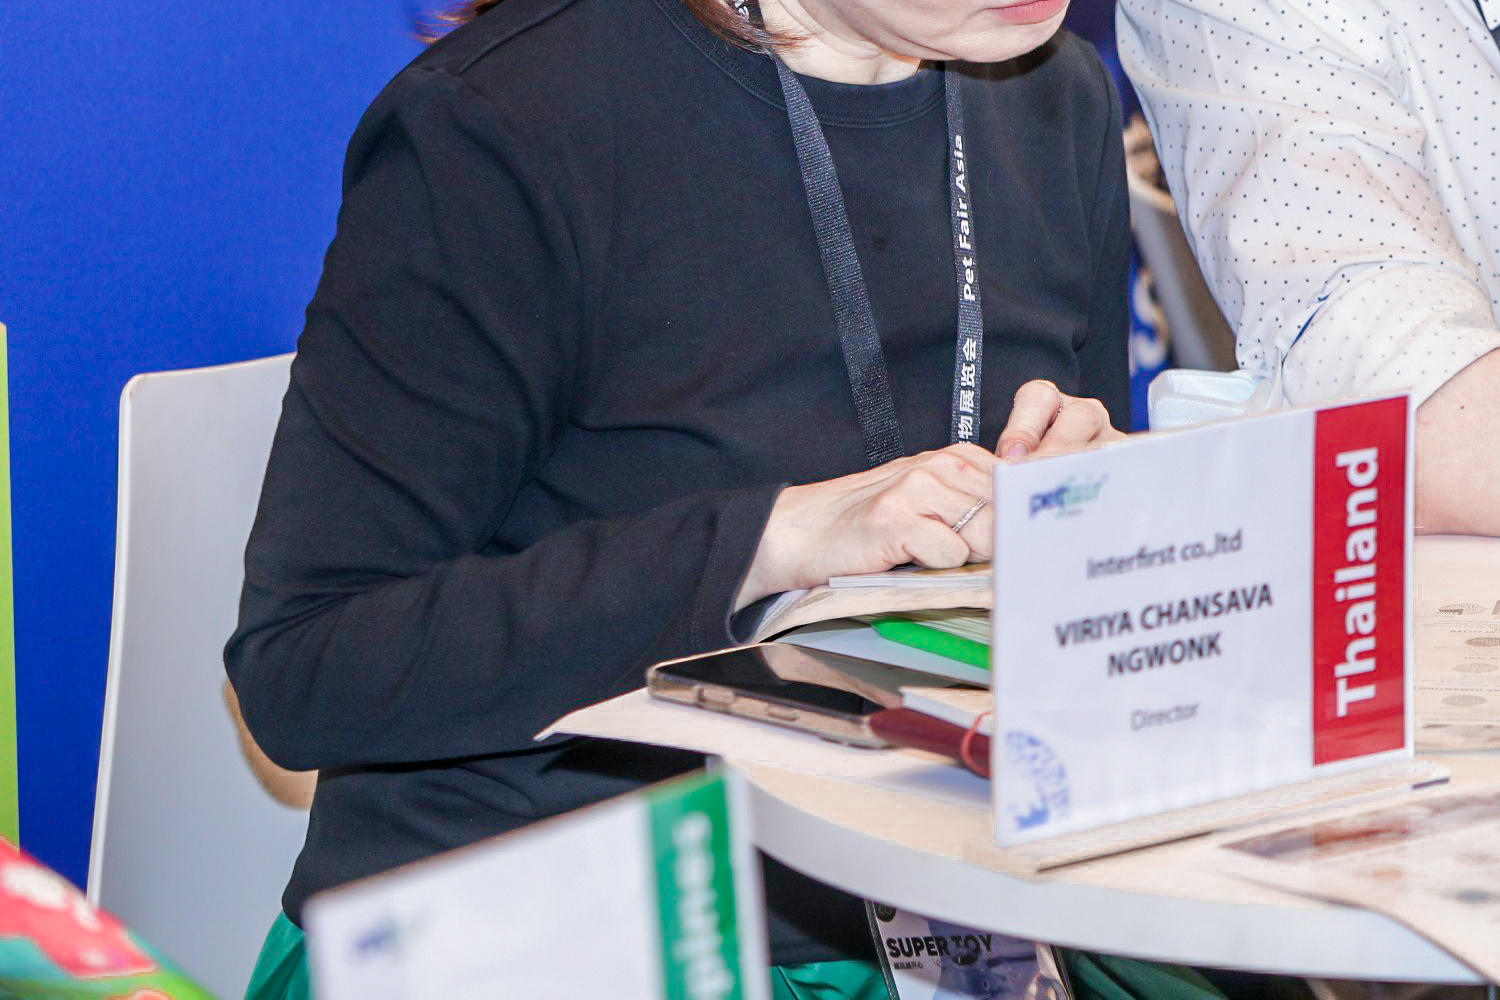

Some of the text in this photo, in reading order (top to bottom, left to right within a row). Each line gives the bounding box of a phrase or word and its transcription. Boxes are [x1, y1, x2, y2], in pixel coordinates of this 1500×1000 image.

[954, 134, 976, 302] Pet Fair Asia
[958, 337, 977, 444] 物展览会
[1086, 544, 1176, 580] Interfirst
[1335, 447, 1380, 717] Thailand
[1054, 582, 1273, 648] VIRIYA CHANSAVA
[1107, 631, 1222, 678] NGWONK
[1130, 703, 1199, 731] Director
[886, 934, 993, 958] SUPER TOY
